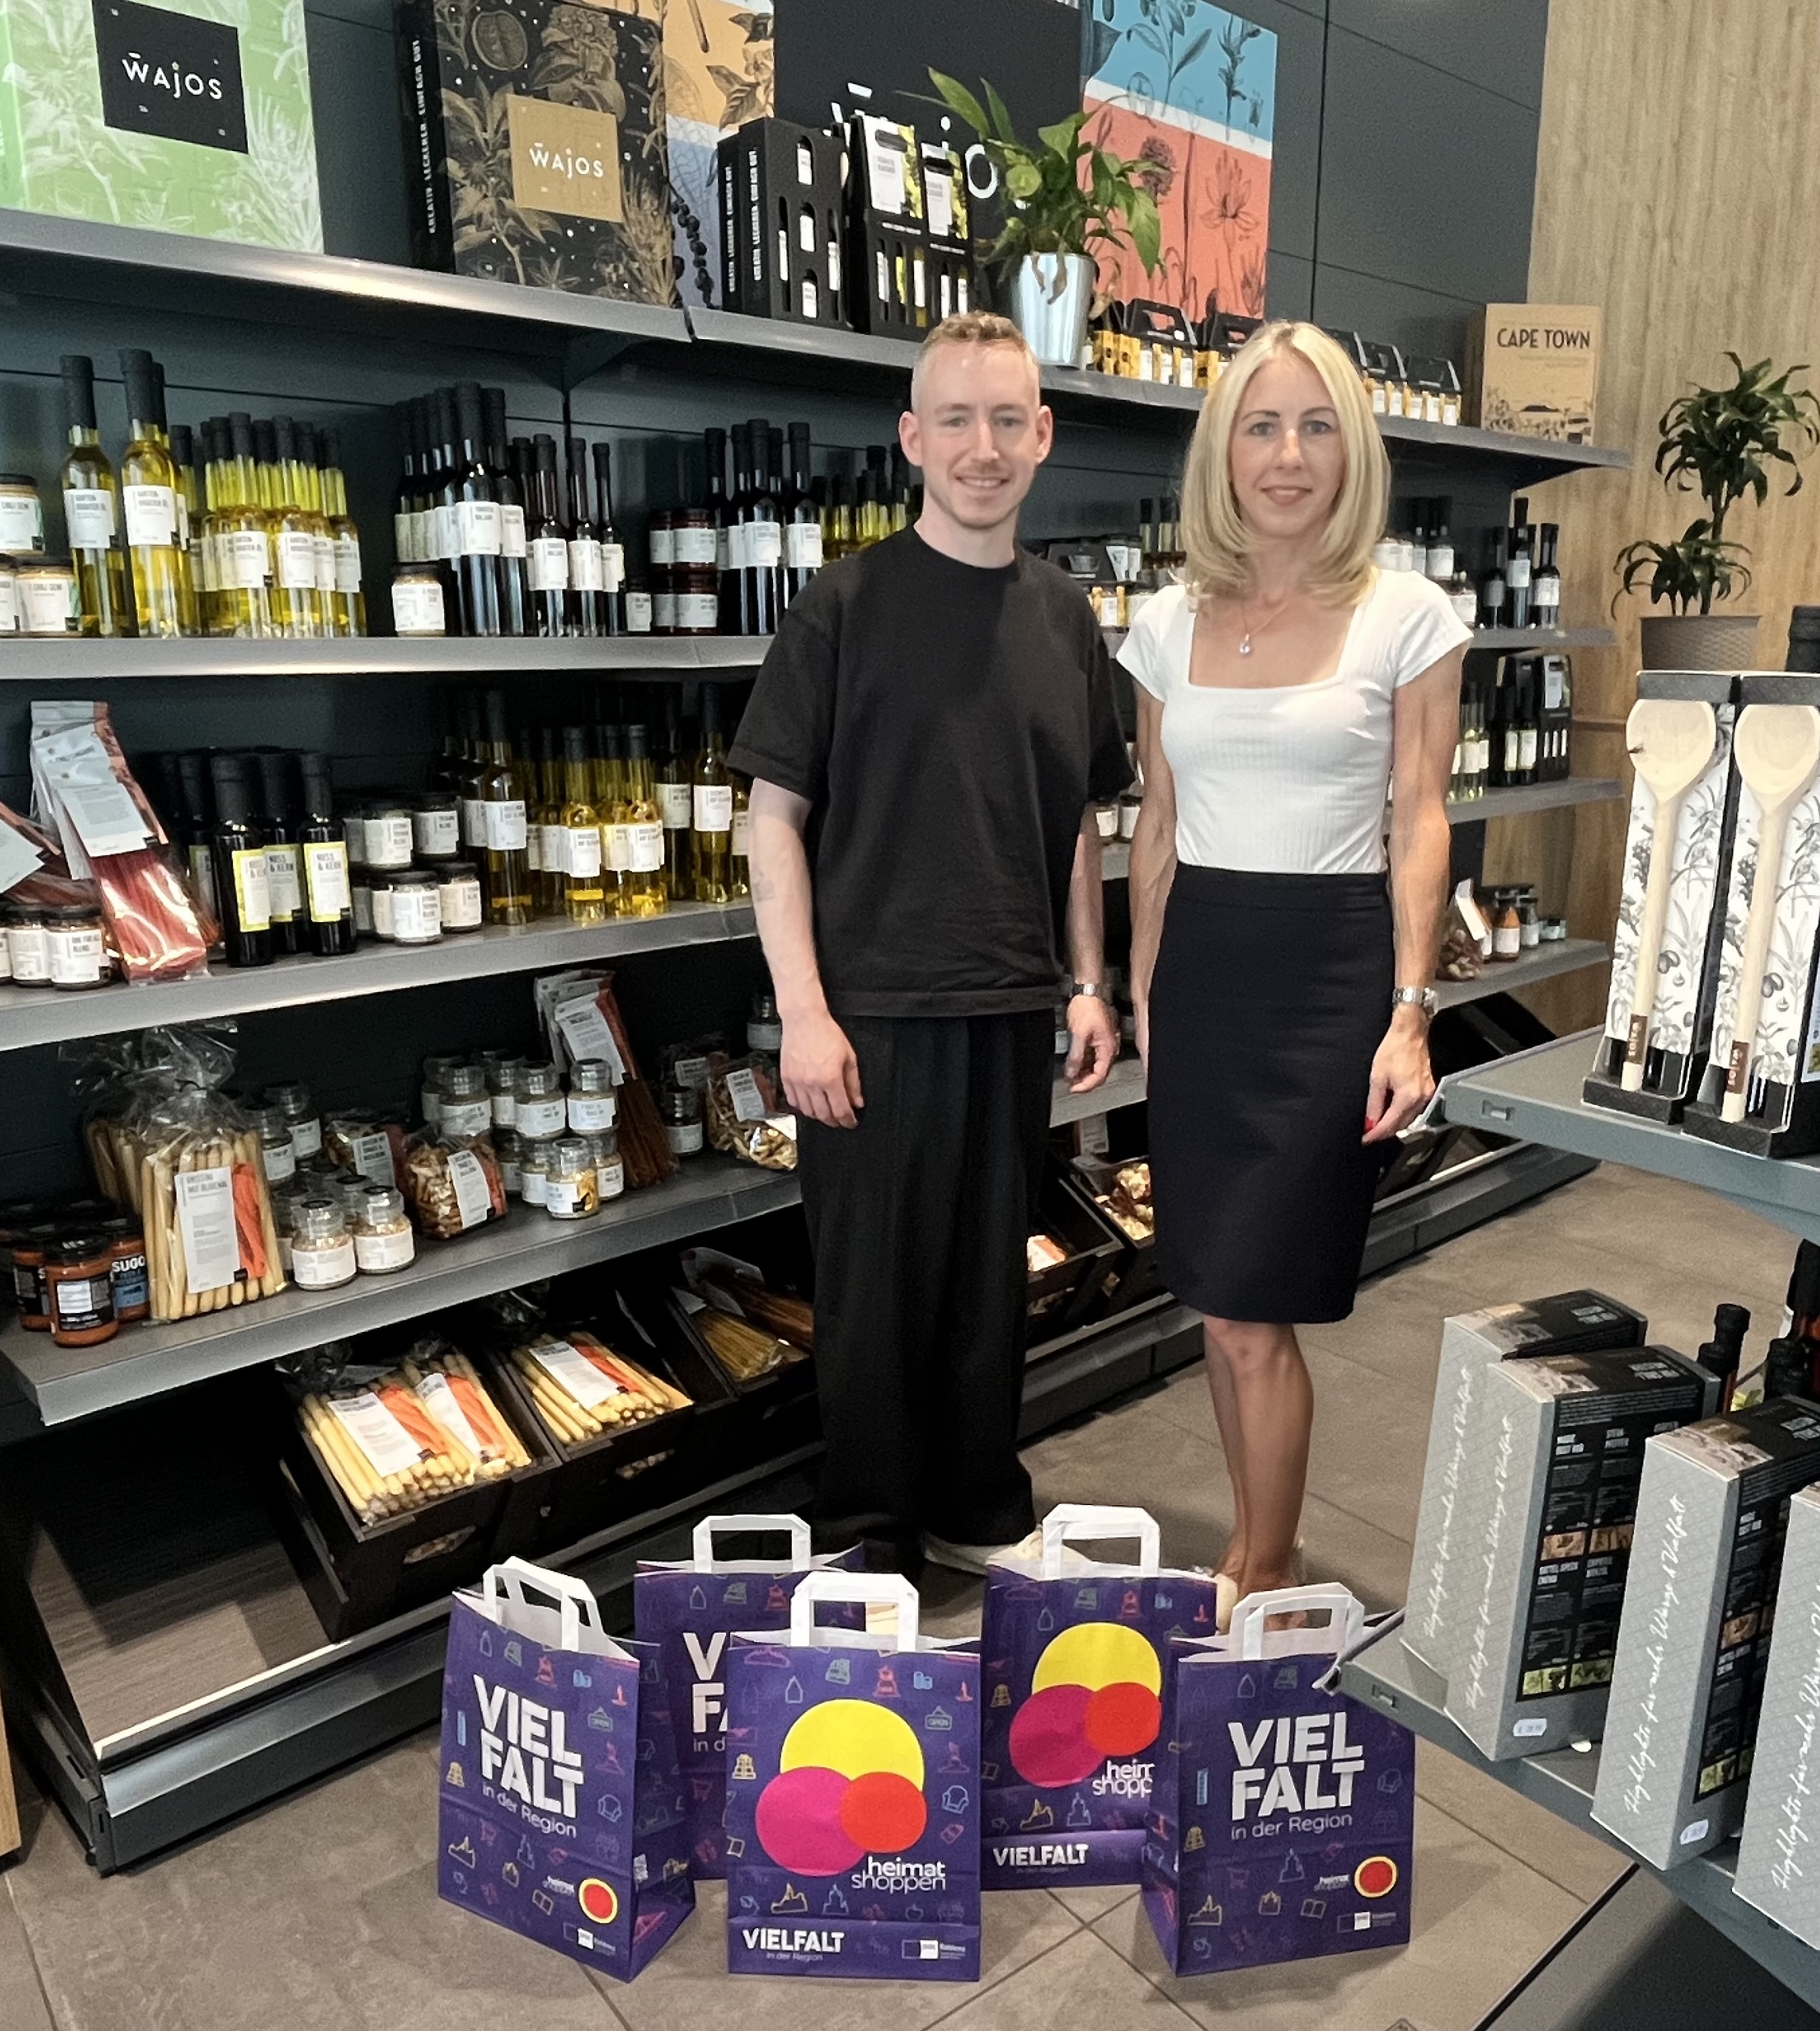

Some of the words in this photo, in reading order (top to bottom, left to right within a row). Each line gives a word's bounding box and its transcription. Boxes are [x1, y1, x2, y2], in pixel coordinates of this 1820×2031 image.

[1497, 328, 1539, 348] CAPE
[1544, 328, 1590, 349] TOWN
[473, 1673, 582, 1768] VIEL
[1228, 1711, 1363, 1767] VIEL
[481, 1727, 584, 1819] FALT
[1092, 1773, 1154, 1799] shopp
[1232, 1760, 1365, 1821] FALT
[482, 1781, 495, 1799] in
[497, 1791, 518, 1813] der
[521, 1805, 577, 1839] Region
[1231, 1825, 1246, 1841] in
[1252, 1821, 1283, 1838] der
[1289, 1813, 1353, 1834] Region
[868, 1856, 946, 1877] heimat
[993, 1843, 1089, 1866] VIELFALT
[851, 1870, 946, 1895] shoppen
[742, 1928, 845, 1953] VIELFALT
